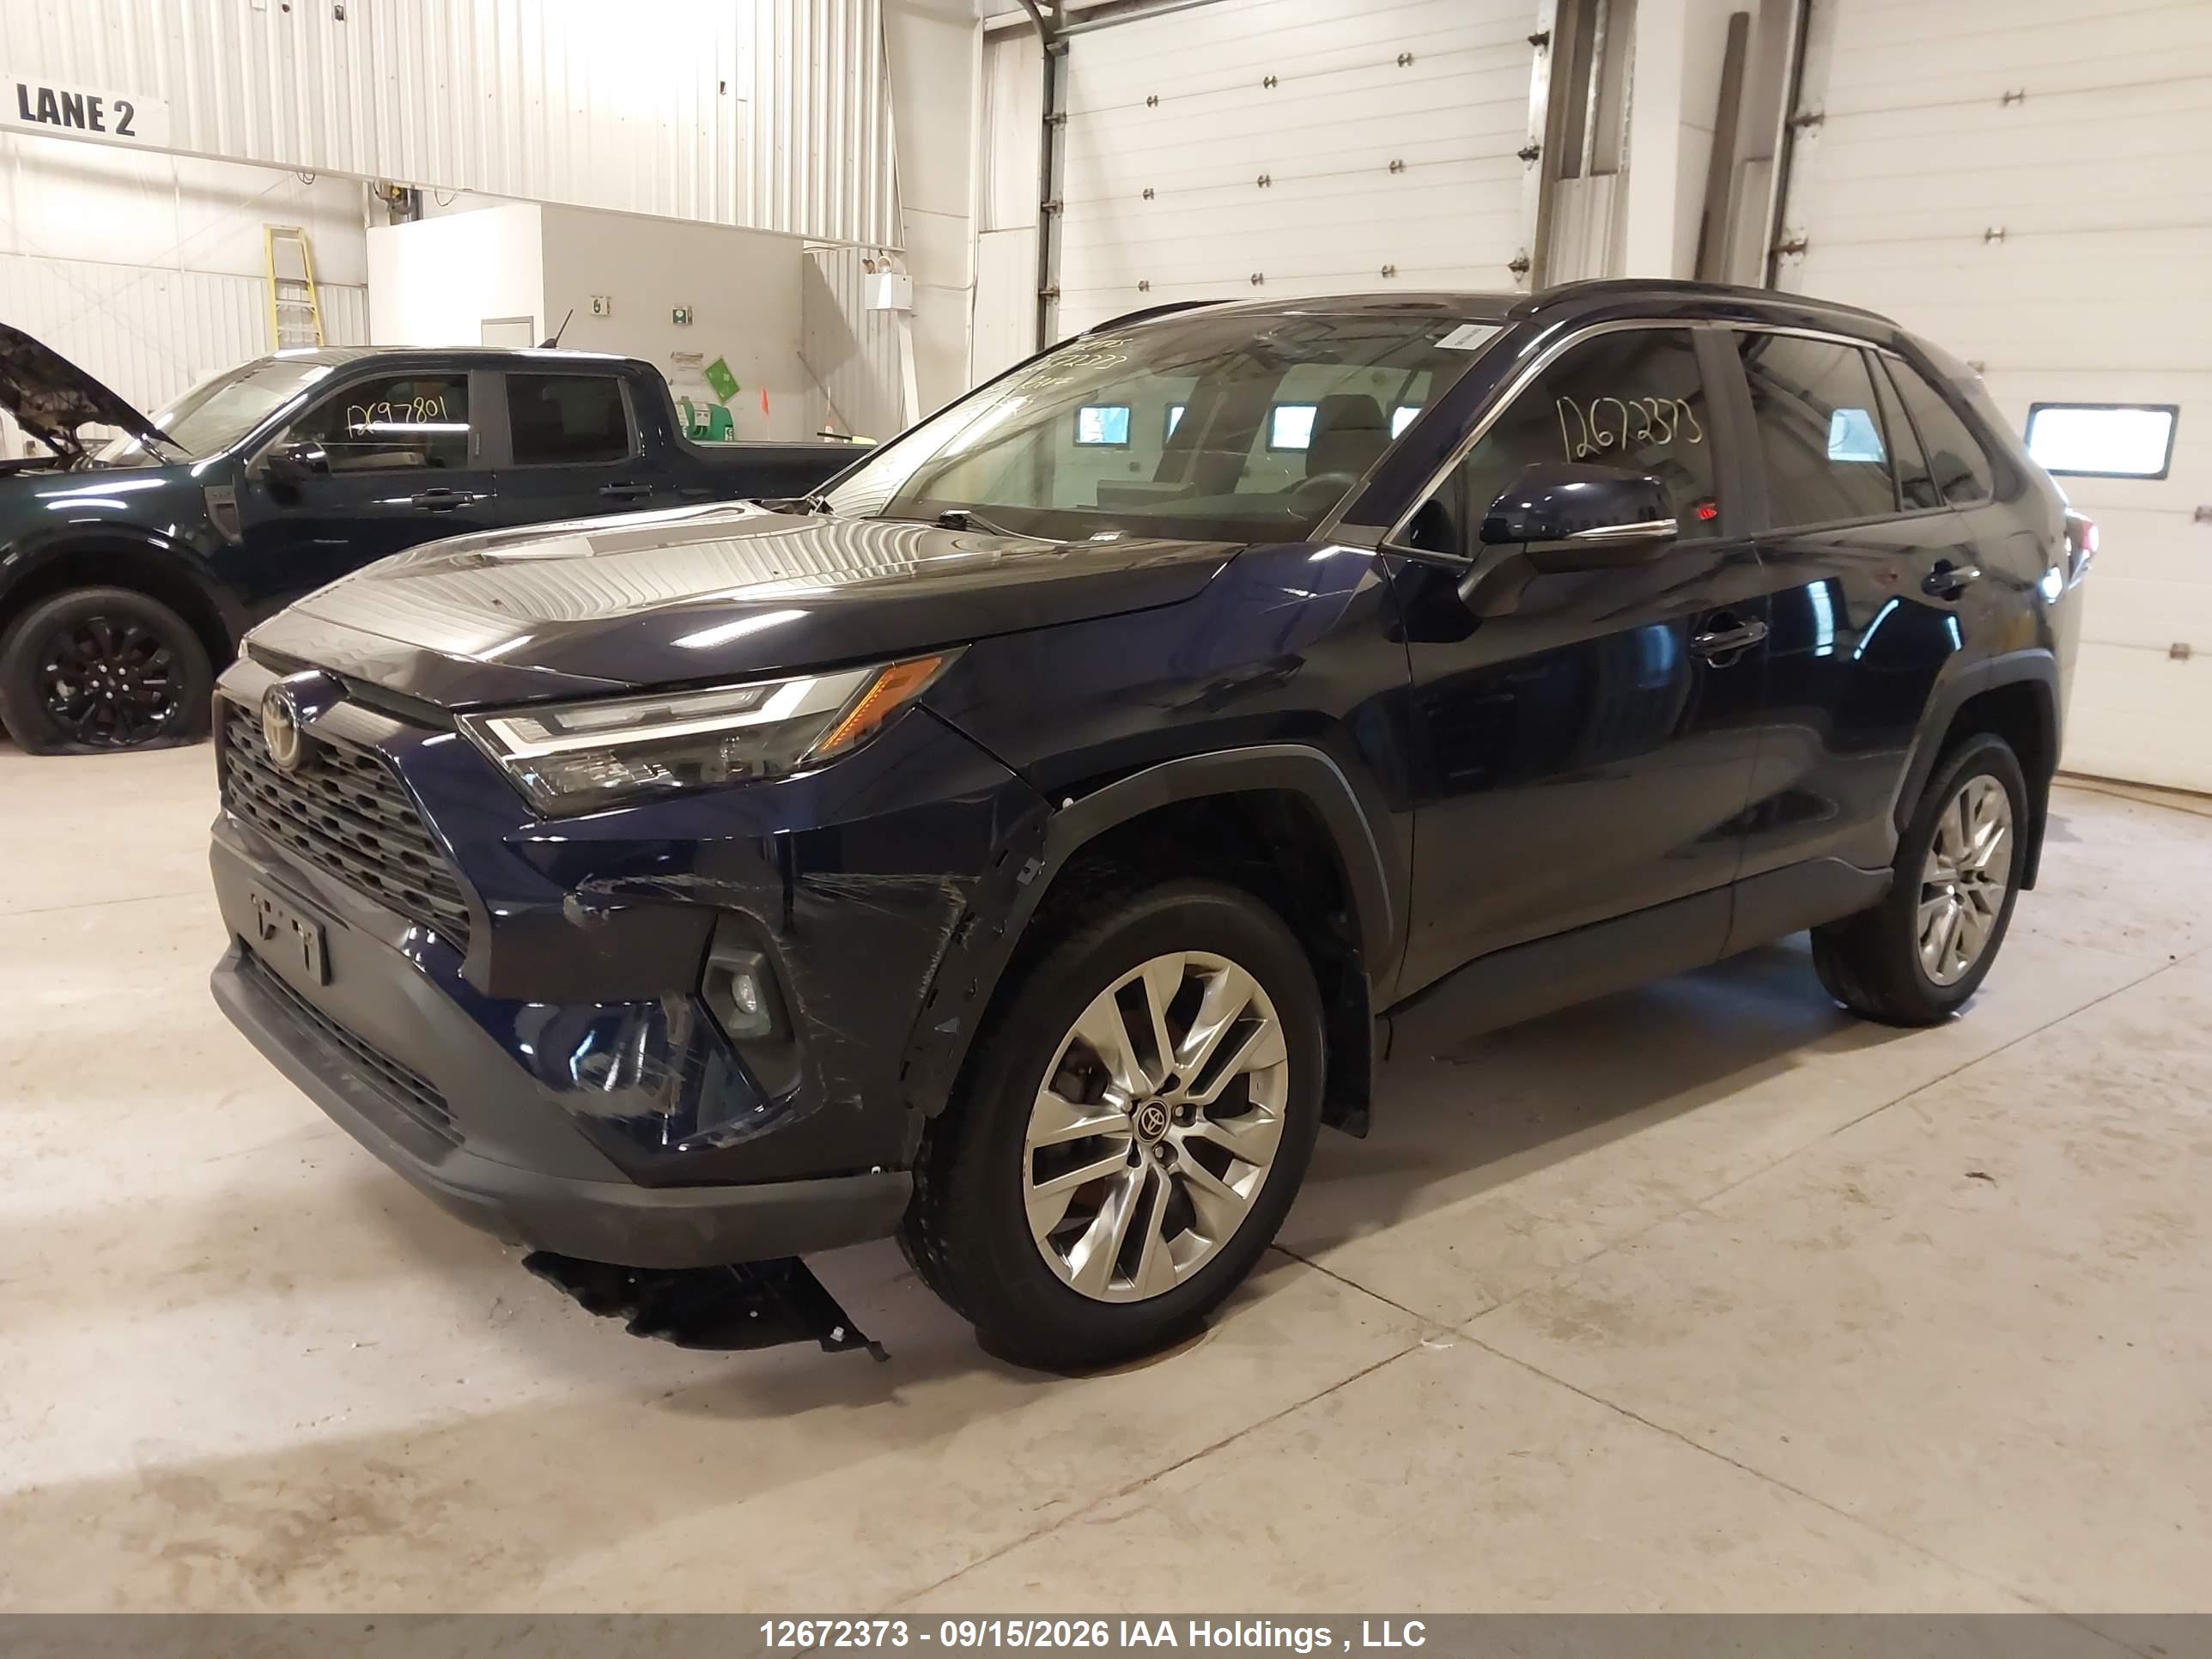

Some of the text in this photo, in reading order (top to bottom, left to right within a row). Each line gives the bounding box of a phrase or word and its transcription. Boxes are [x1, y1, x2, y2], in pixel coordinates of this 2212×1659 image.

[16, 82, 136, 137] LANE 2
[1556, 395, 1704, 465] 12672373
